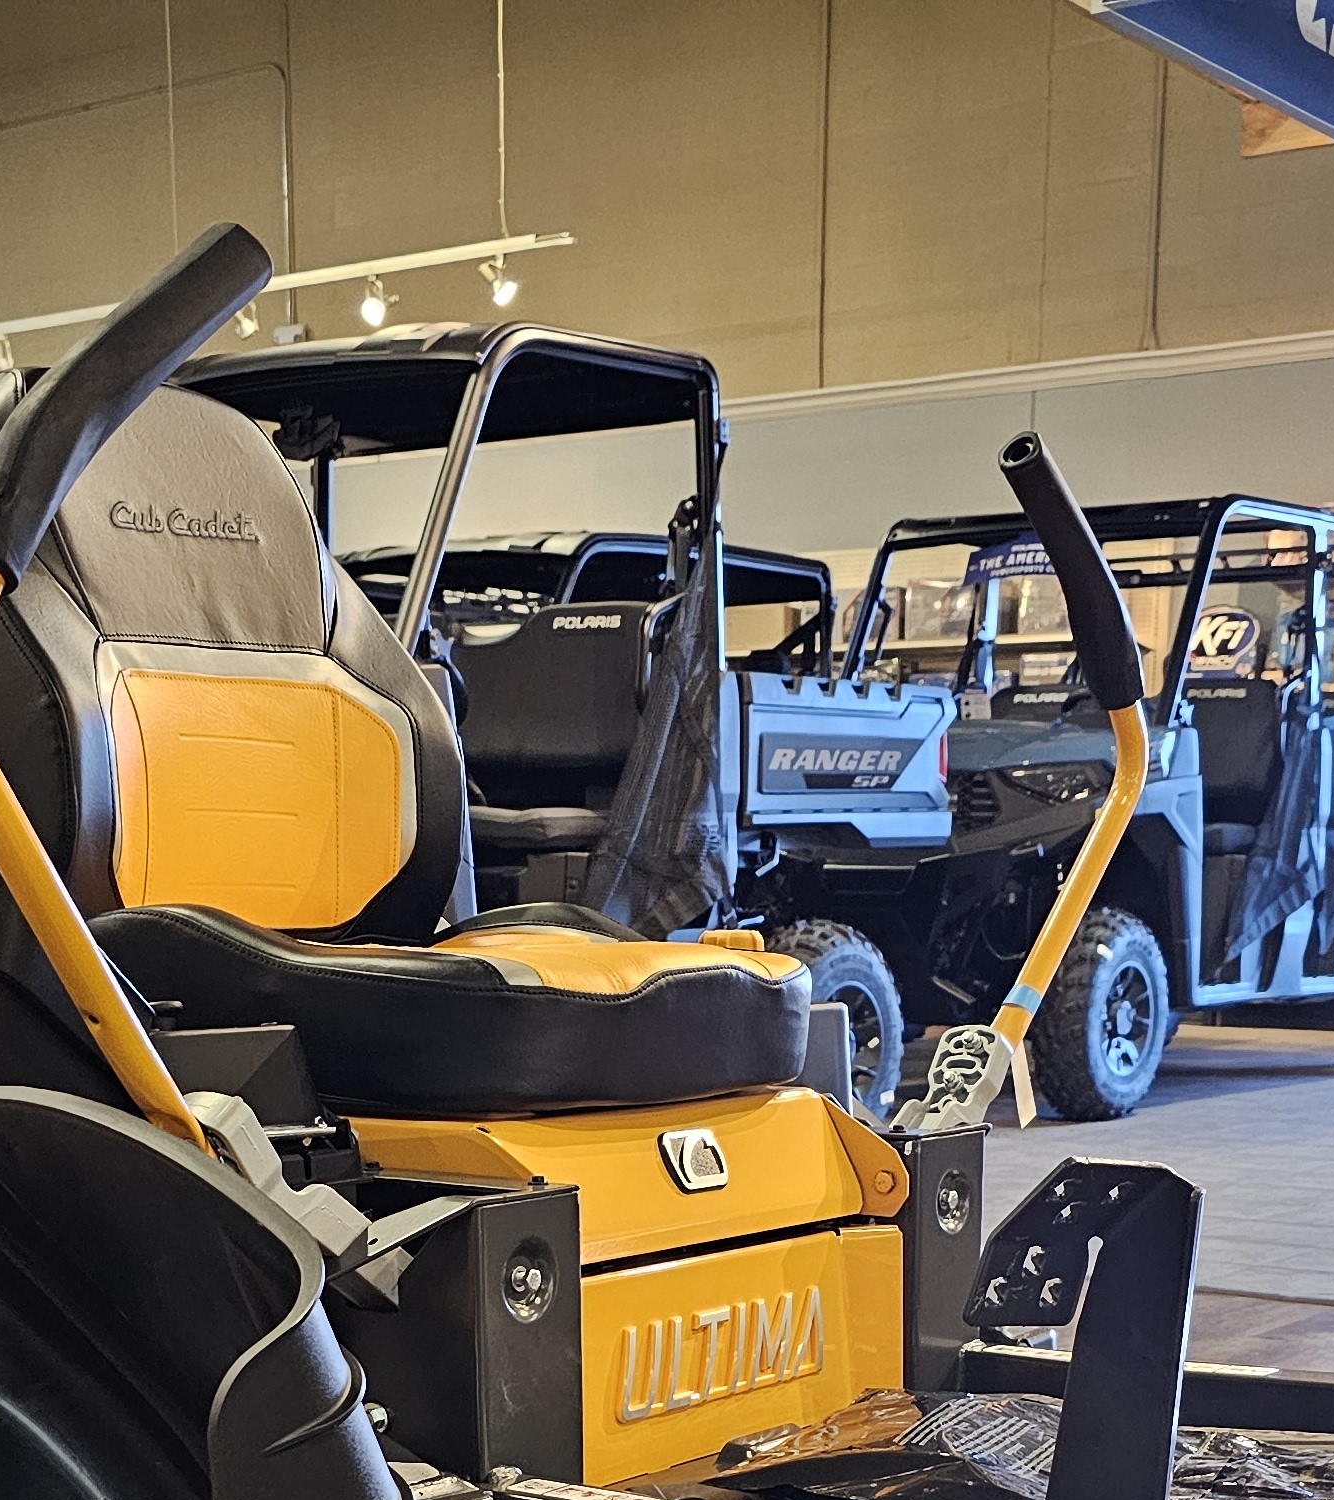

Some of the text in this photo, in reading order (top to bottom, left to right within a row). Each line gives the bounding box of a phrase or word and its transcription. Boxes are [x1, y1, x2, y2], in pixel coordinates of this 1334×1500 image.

[110, 500, 258, 541] Cub Cadet
[552, 615, 621, 629] POLARIS
[768, 749, 902, 771] RANGER
[851, 775, 890, 788] SP
[615, 1285, 824, 1424] ULTIMA
